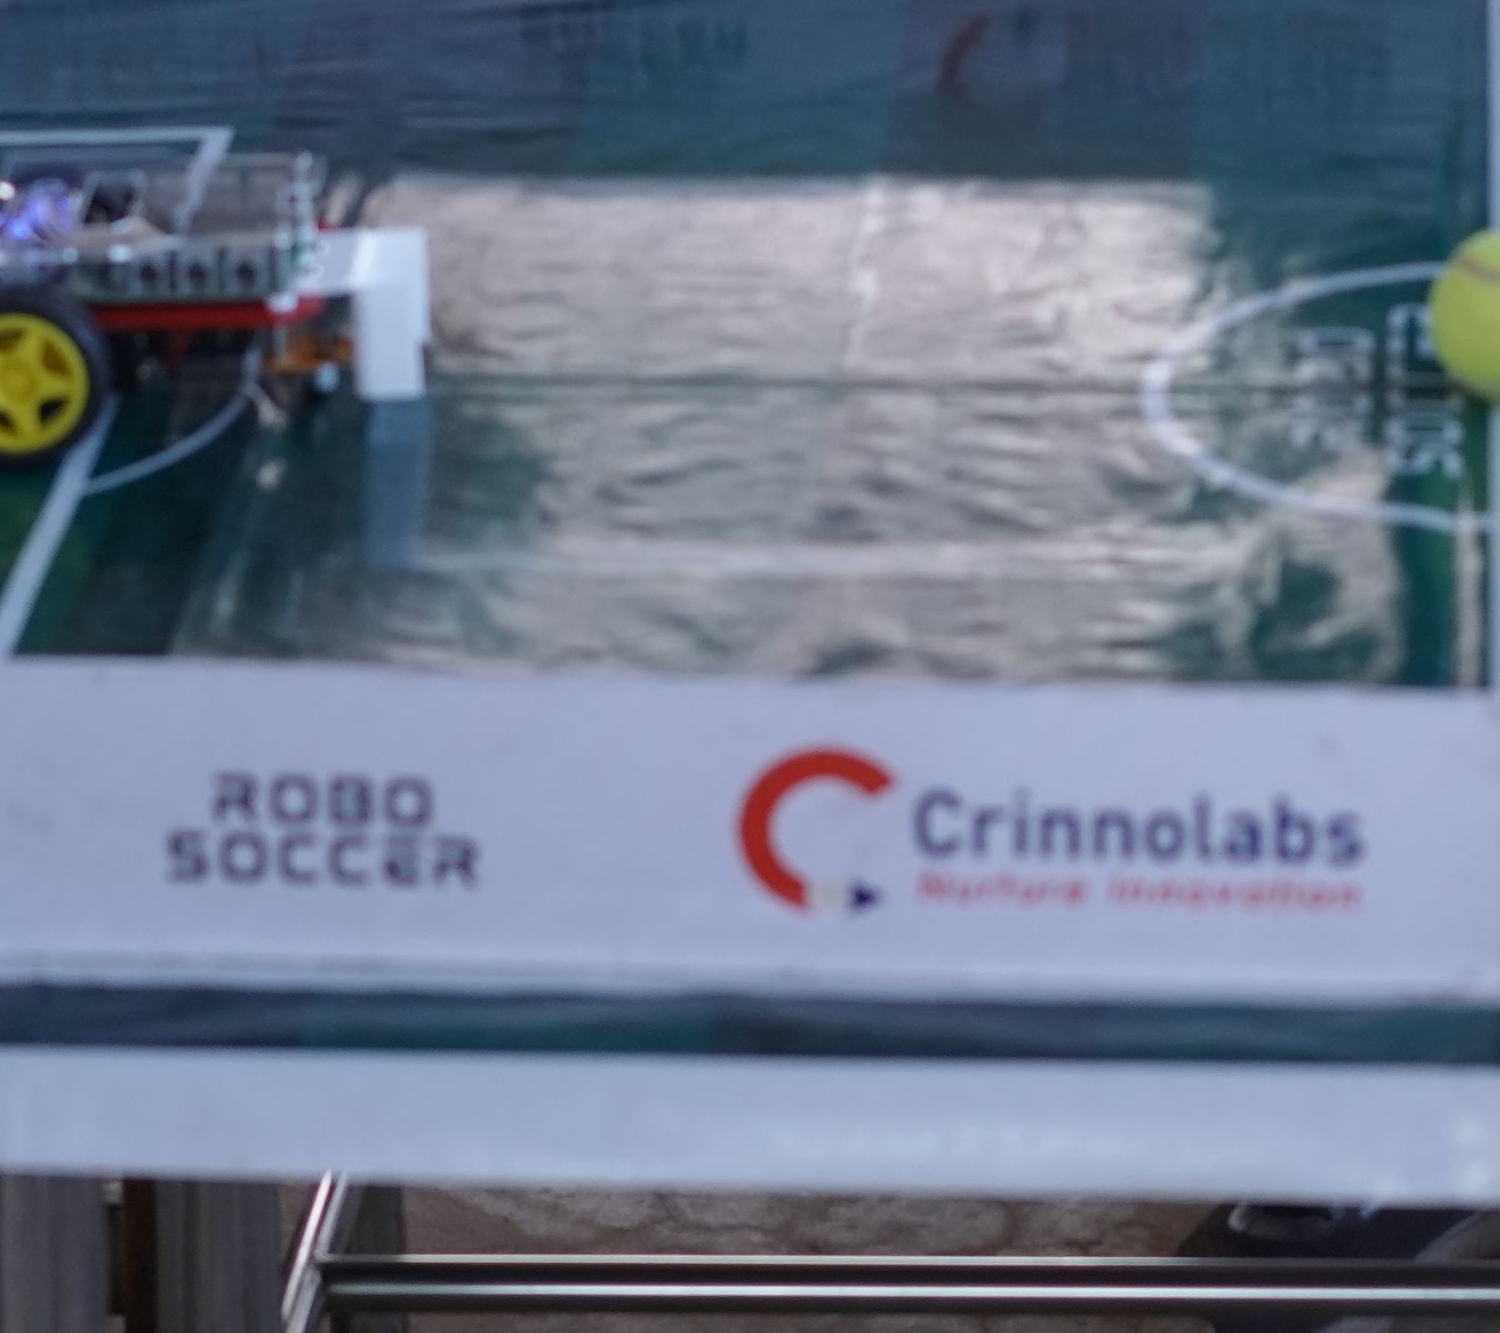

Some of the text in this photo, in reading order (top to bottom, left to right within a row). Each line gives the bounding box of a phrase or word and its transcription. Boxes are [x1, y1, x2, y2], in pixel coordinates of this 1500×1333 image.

[210, 771, 435, 829] ROBO
[911, 786, 1365, 866] Crinnolabs
[165, 828, 479, 889] SOCCER
